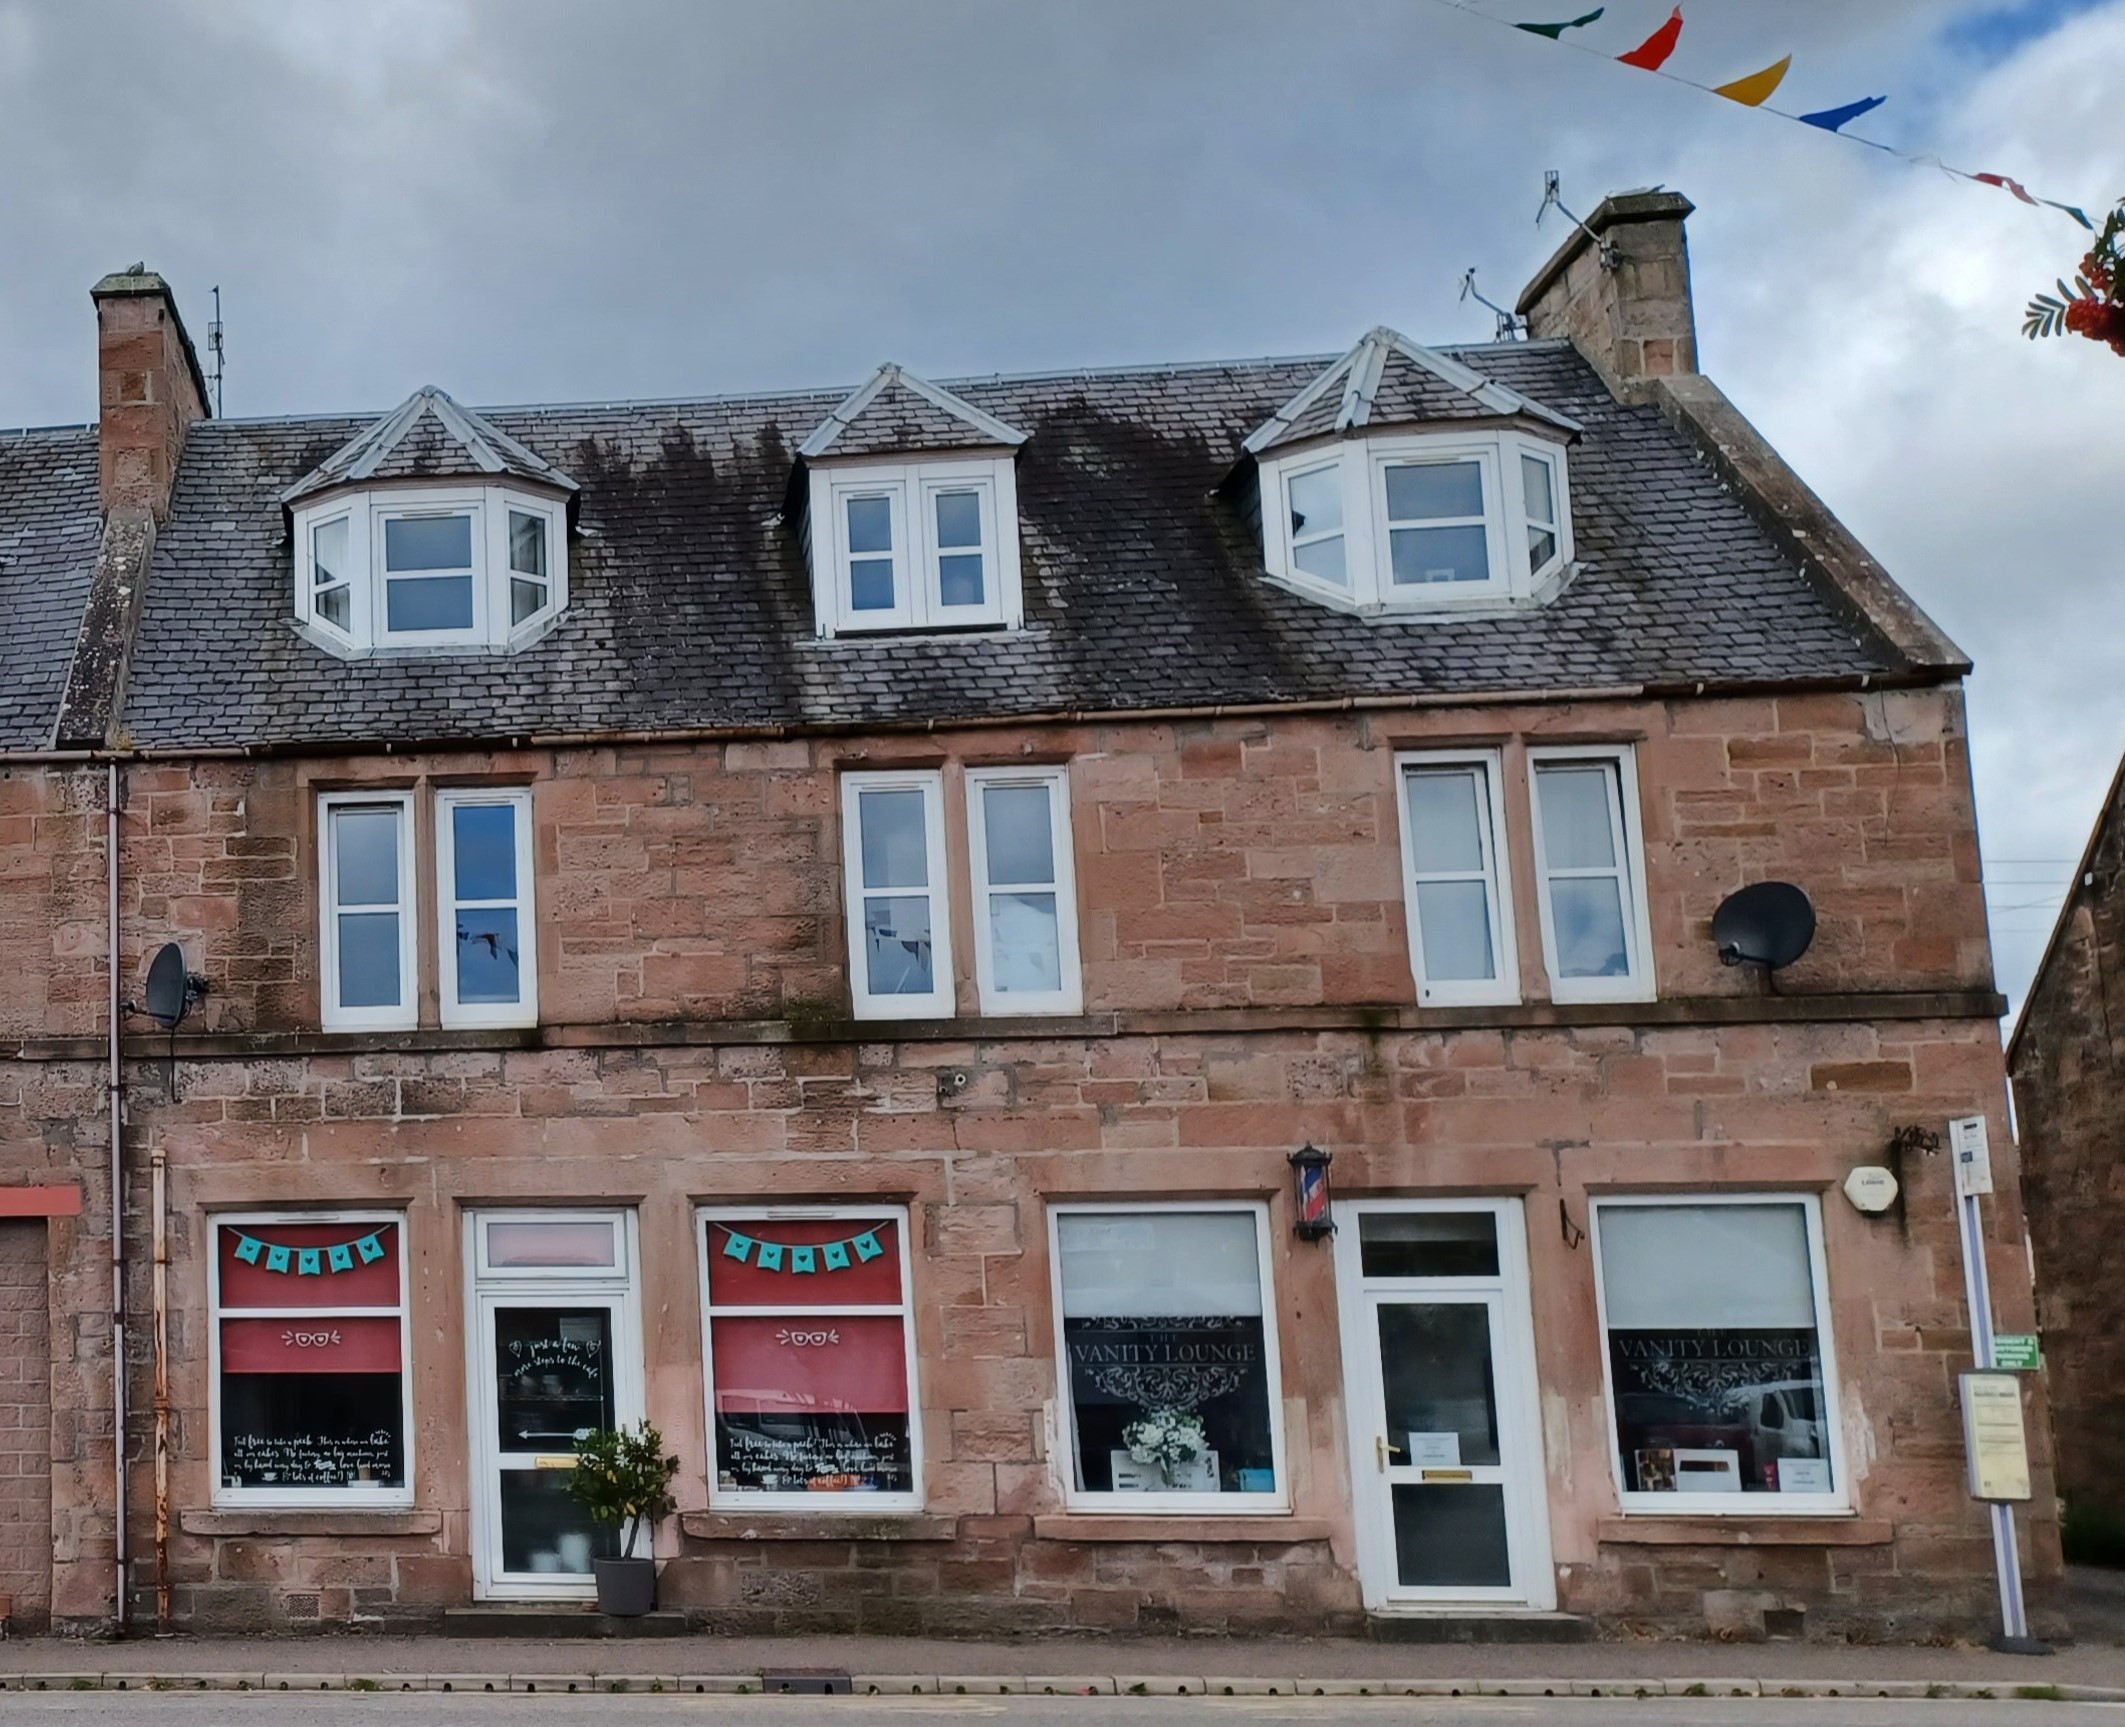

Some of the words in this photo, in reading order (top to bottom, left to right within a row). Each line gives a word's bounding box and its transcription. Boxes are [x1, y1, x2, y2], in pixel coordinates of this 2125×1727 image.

[1074, 1344, 1158, 1362] VANITY
[1165, 1344, 1257, 1362] LOUNGE
[1618, 1339, 1705, 1357] VANITY
[1712, 1338, 1811, 1357] LOUNGE
